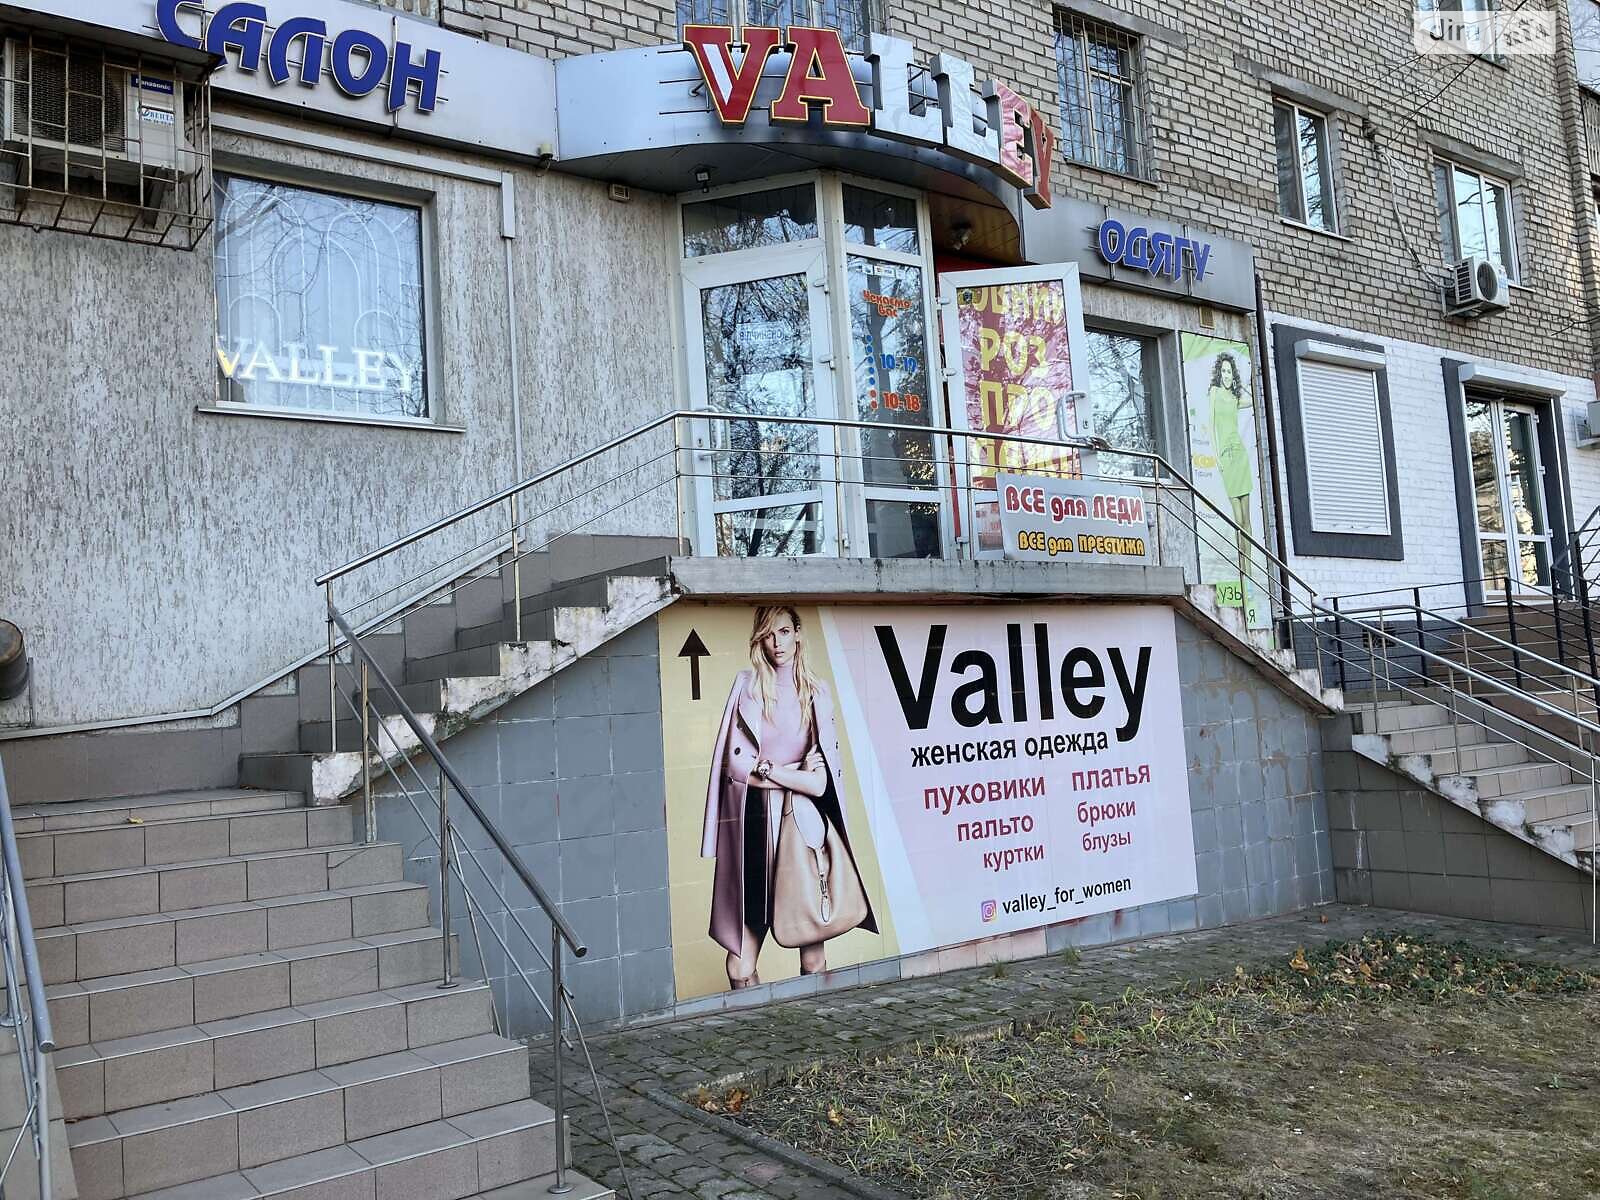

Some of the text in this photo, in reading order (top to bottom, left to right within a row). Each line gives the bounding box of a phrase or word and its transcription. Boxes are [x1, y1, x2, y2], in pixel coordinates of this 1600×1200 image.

[155, 0, 441, 112] САЛОН
[683, 24, 1055, 209] VALLEY
[1099, 219, 1211, 282] ОДЯГУ
[216, 335, 413, 393] VALLEY
[979, 327, 1049, 377] РОЗ
[980, 380, 1055, 430] ПРО
[1005, 485, 1143, 525] ВСЕ для ЛЕДИ
[1018, 531, 1146, 556] ВСЕ для ПРЕСТИЖА
[873, 622, 1152, 743] Valley
[911, 731, 1109, 768] женская одежда
[924, 776, 1046, 815] пуховики
[1071, 764, 1151, 791] платья
[957, 814, 1034, 842] пальто
[1077, 801, 1136, 827] брюки
[983, 844, 1044, 872] куртки
[1082, 831, 1131, 854] блузы
[1002, 877, 1132, 915] valley_for_women
